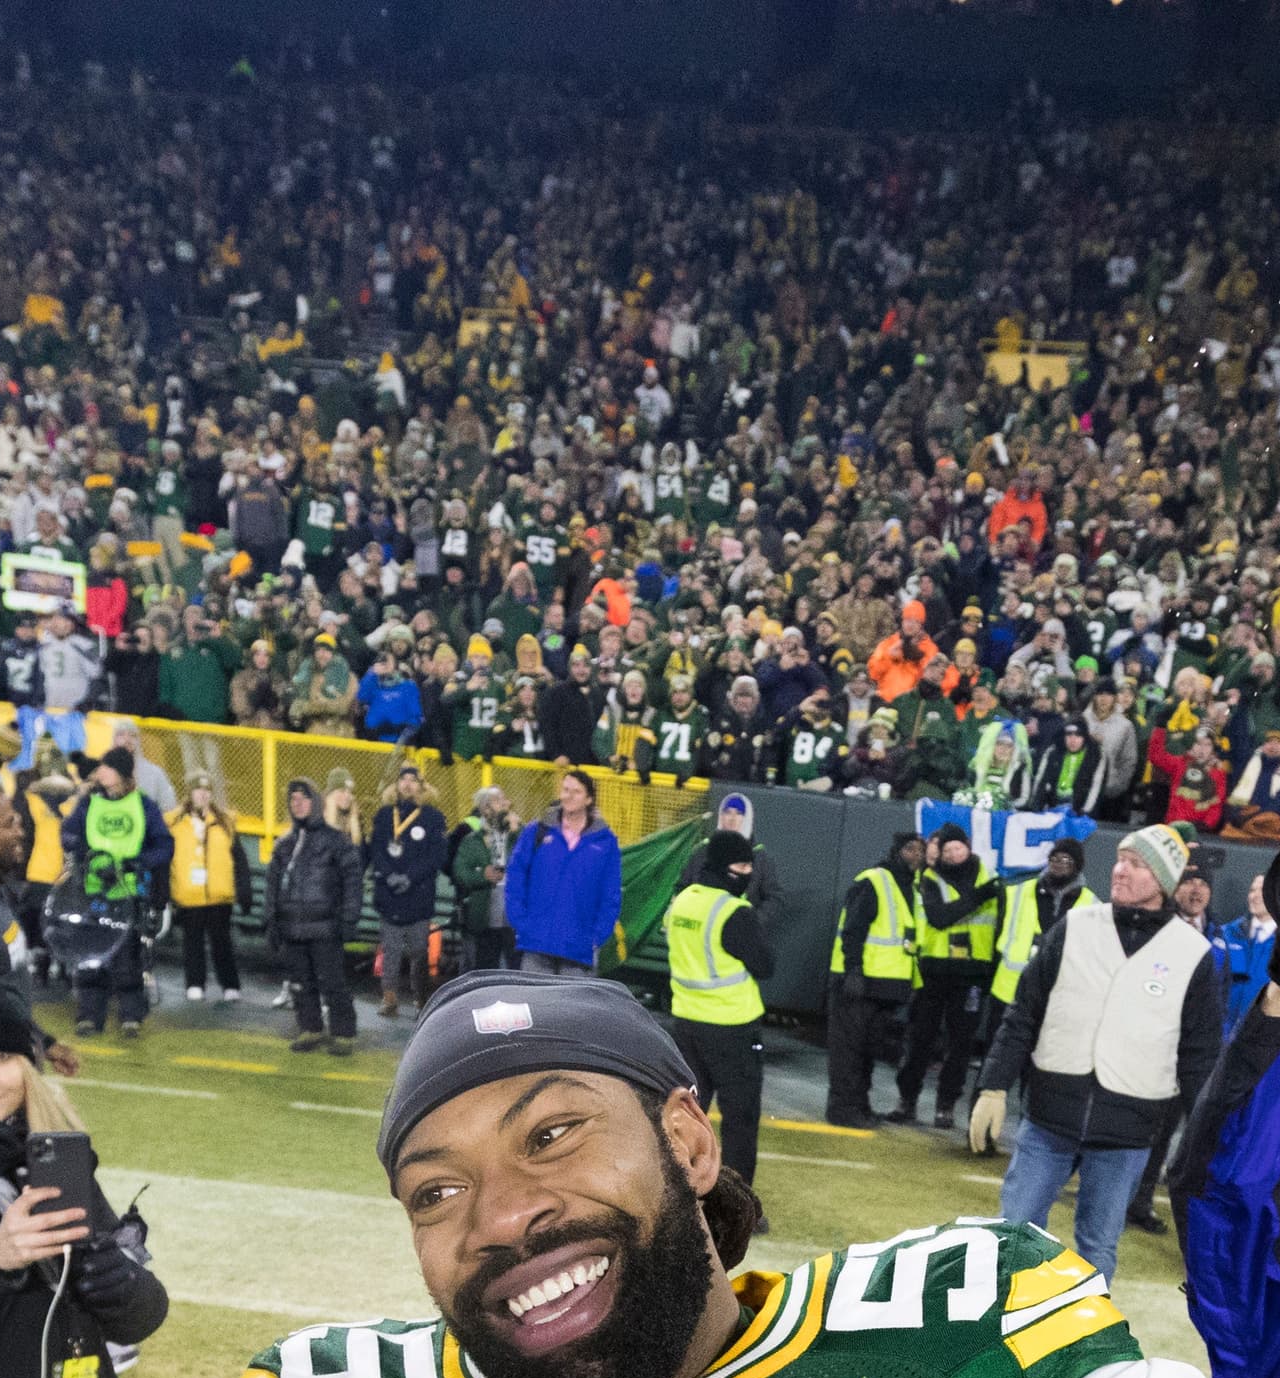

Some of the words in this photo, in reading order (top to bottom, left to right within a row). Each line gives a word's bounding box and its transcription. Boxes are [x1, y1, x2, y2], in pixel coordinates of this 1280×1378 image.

[307, 500, 335, 529] 12
[526, 535, 558, 565] 55
[470, 696, 498, 728] 12
[660, 721, 692, 761] 71
